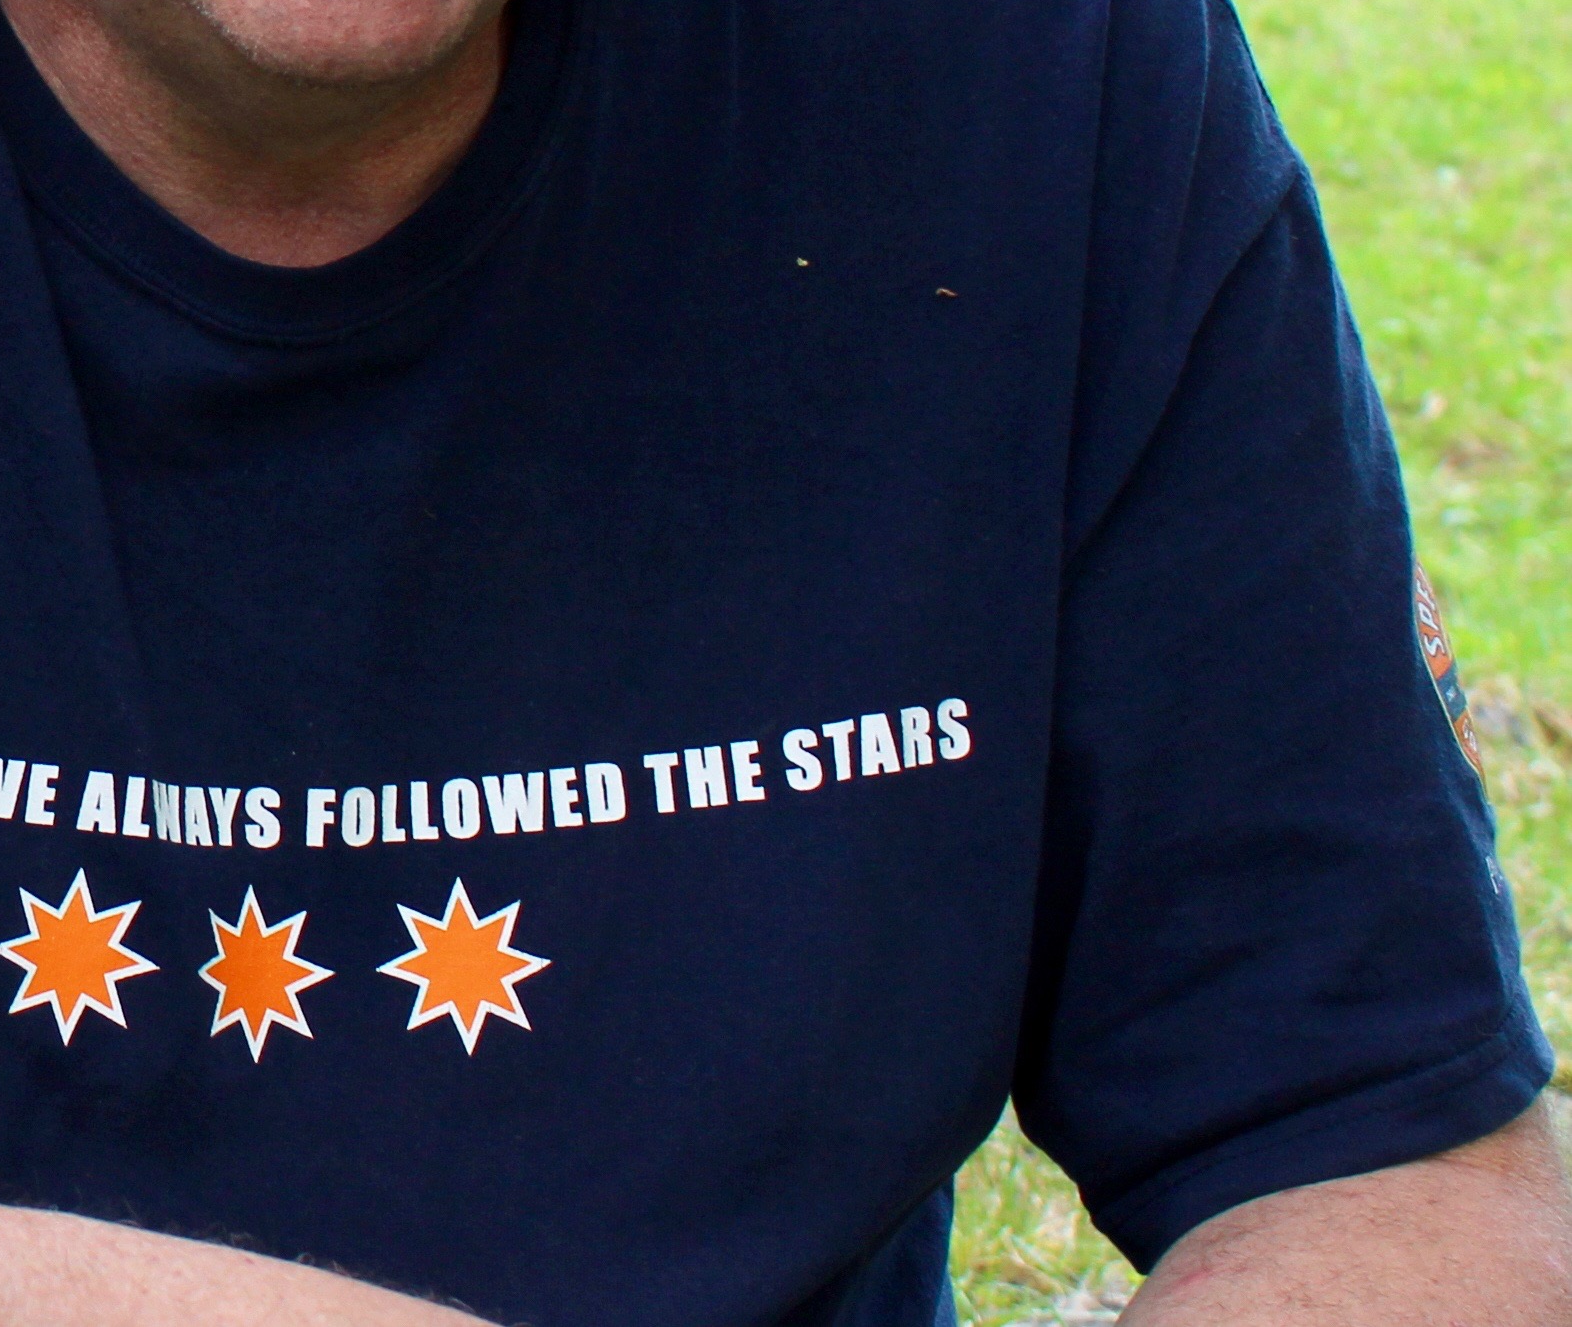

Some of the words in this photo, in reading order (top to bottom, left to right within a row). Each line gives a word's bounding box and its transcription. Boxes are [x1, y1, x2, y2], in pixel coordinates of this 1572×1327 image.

[76, 771, 281, 848] ALWAYS
[306, 763, 626, 847] FOLLOWED
[643, 740, 765, 813] THE
[783, 697, 971, 791] STARS
